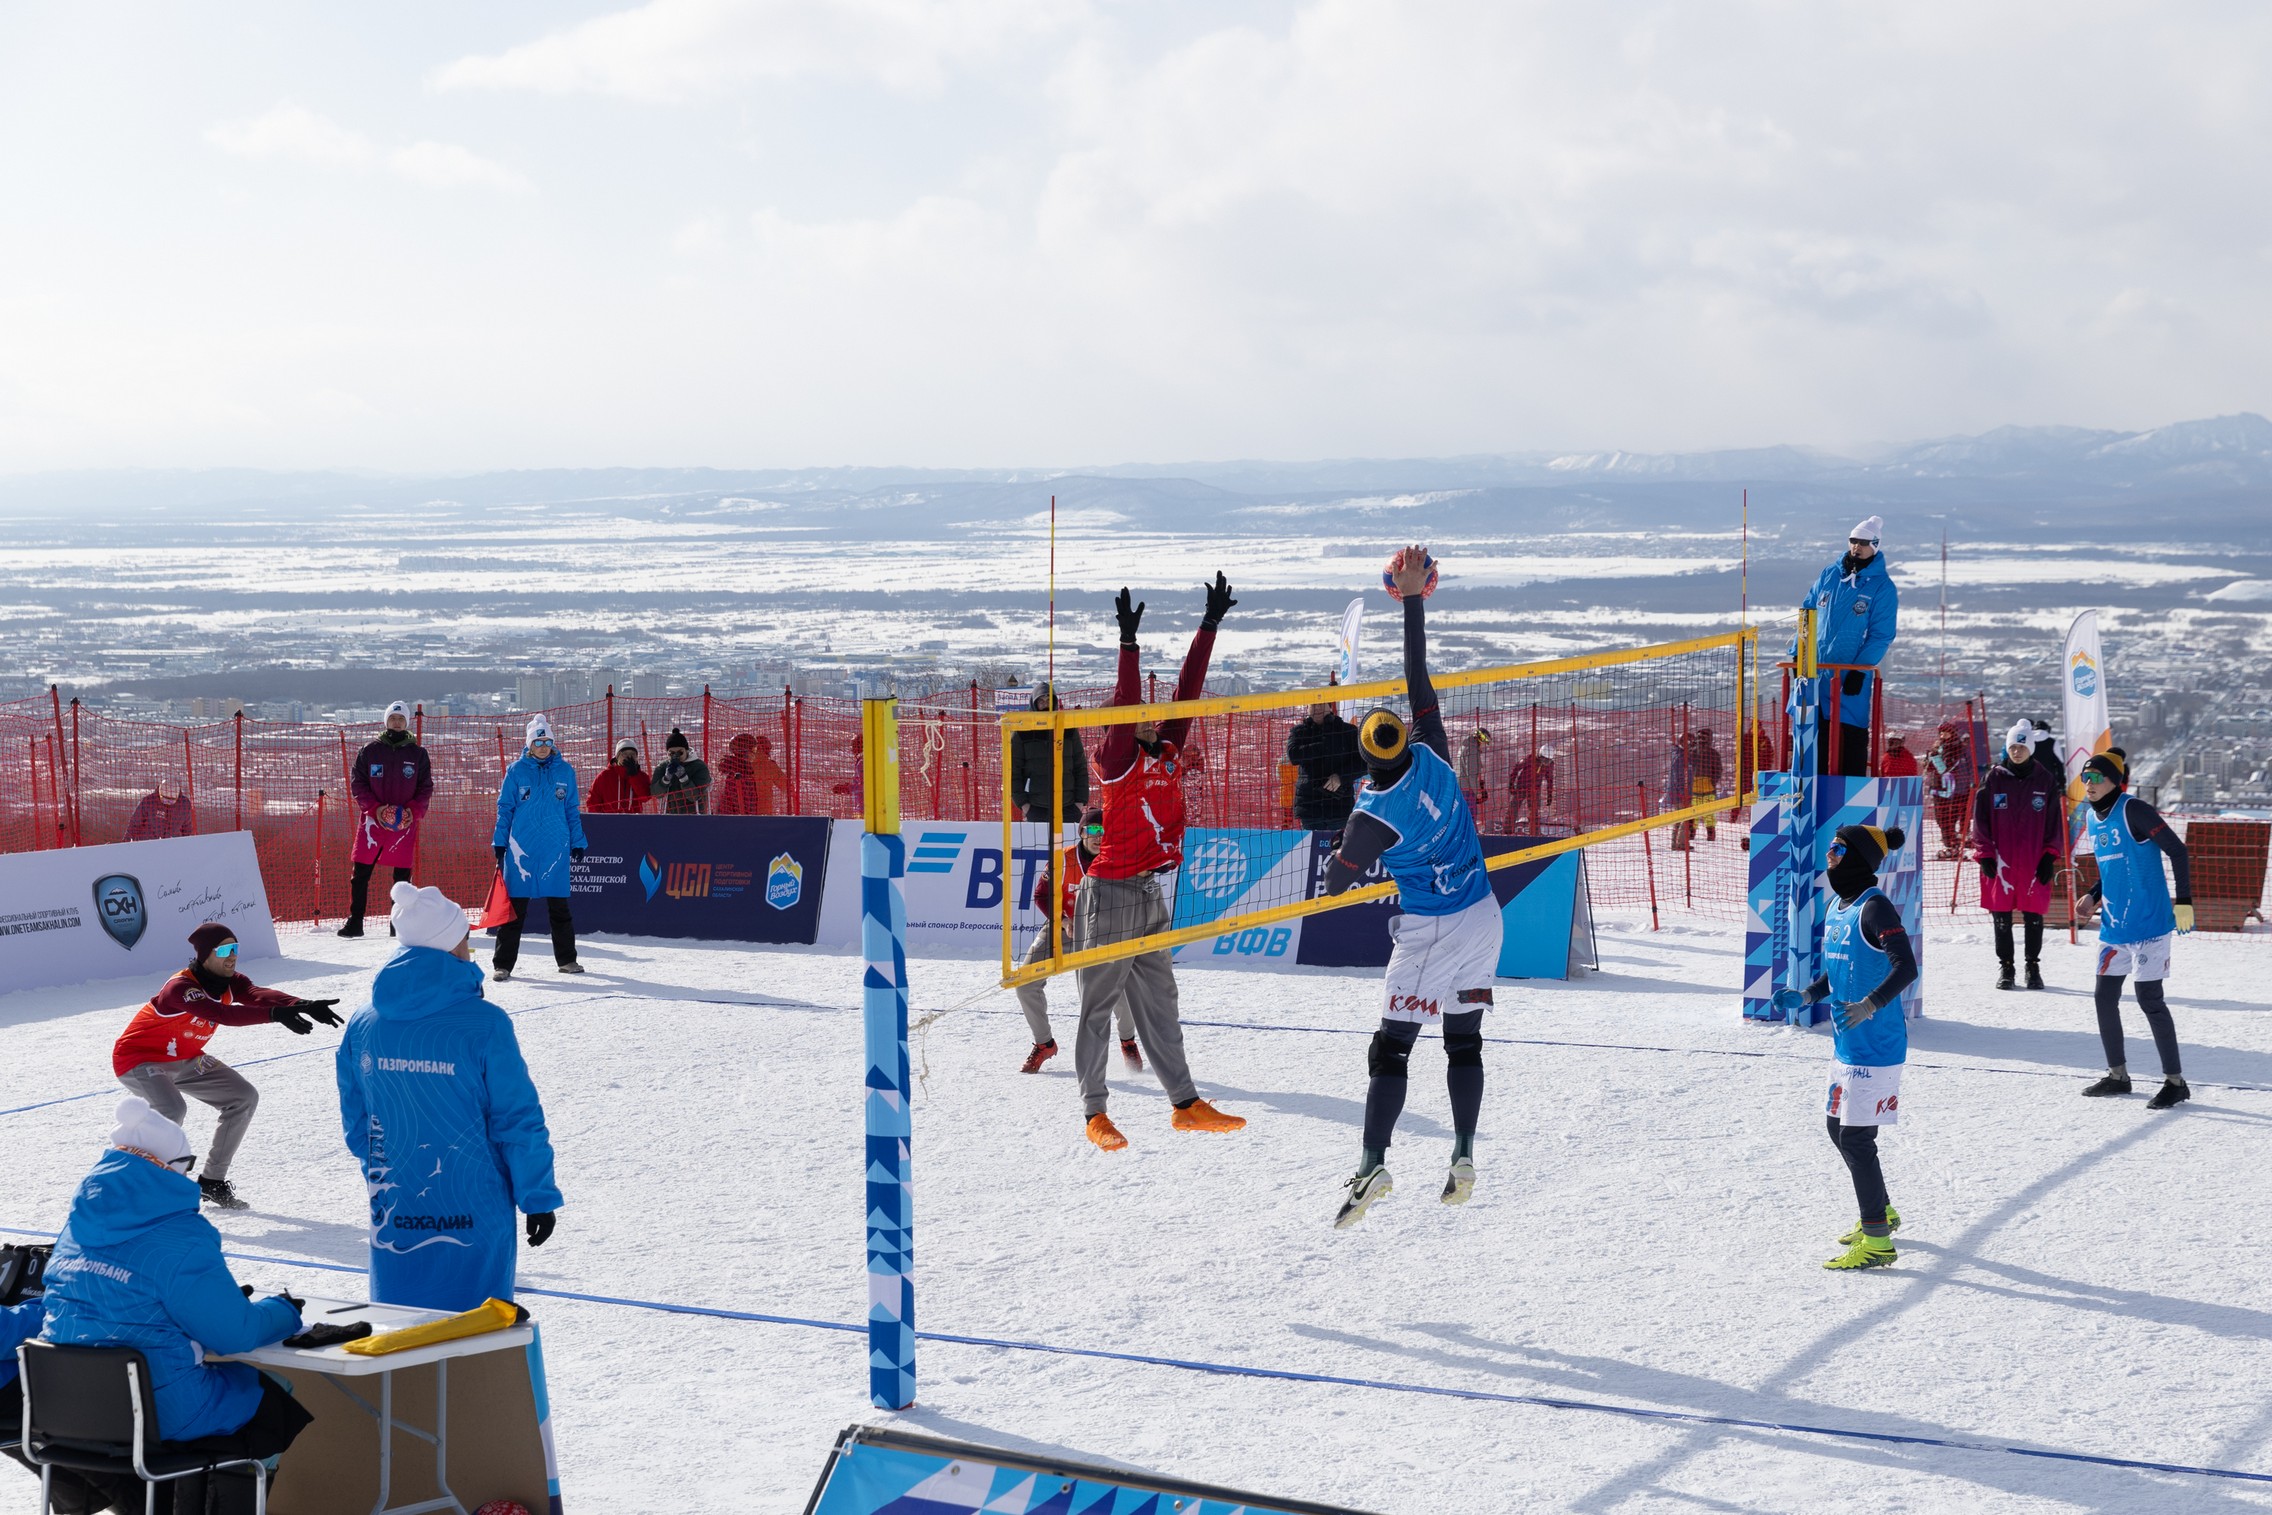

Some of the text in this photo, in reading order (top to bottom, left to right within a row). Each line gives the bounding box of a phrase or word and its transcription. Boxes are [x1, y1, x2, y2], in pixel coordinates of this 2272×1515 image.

[1417, 791, 1442, 821] 1
[2111, 828, 2121, 846] 3
[570, 875, 627, 884] САХАЛИНСКОЙ
[666, 863, 711, 899] ЦСП
[966, 848, 1049, 910] ВТ
[906, 920, 1042, 933] ьный спонсор Всероссийсй феде
[1841, 924, 1851, 945] 2
[1212, 927, 1292, 957] ВФВ
[378, 1057, 455, 1076] ГАЗПРОМБАНК
[27, 1259, 37, 1275] 0
